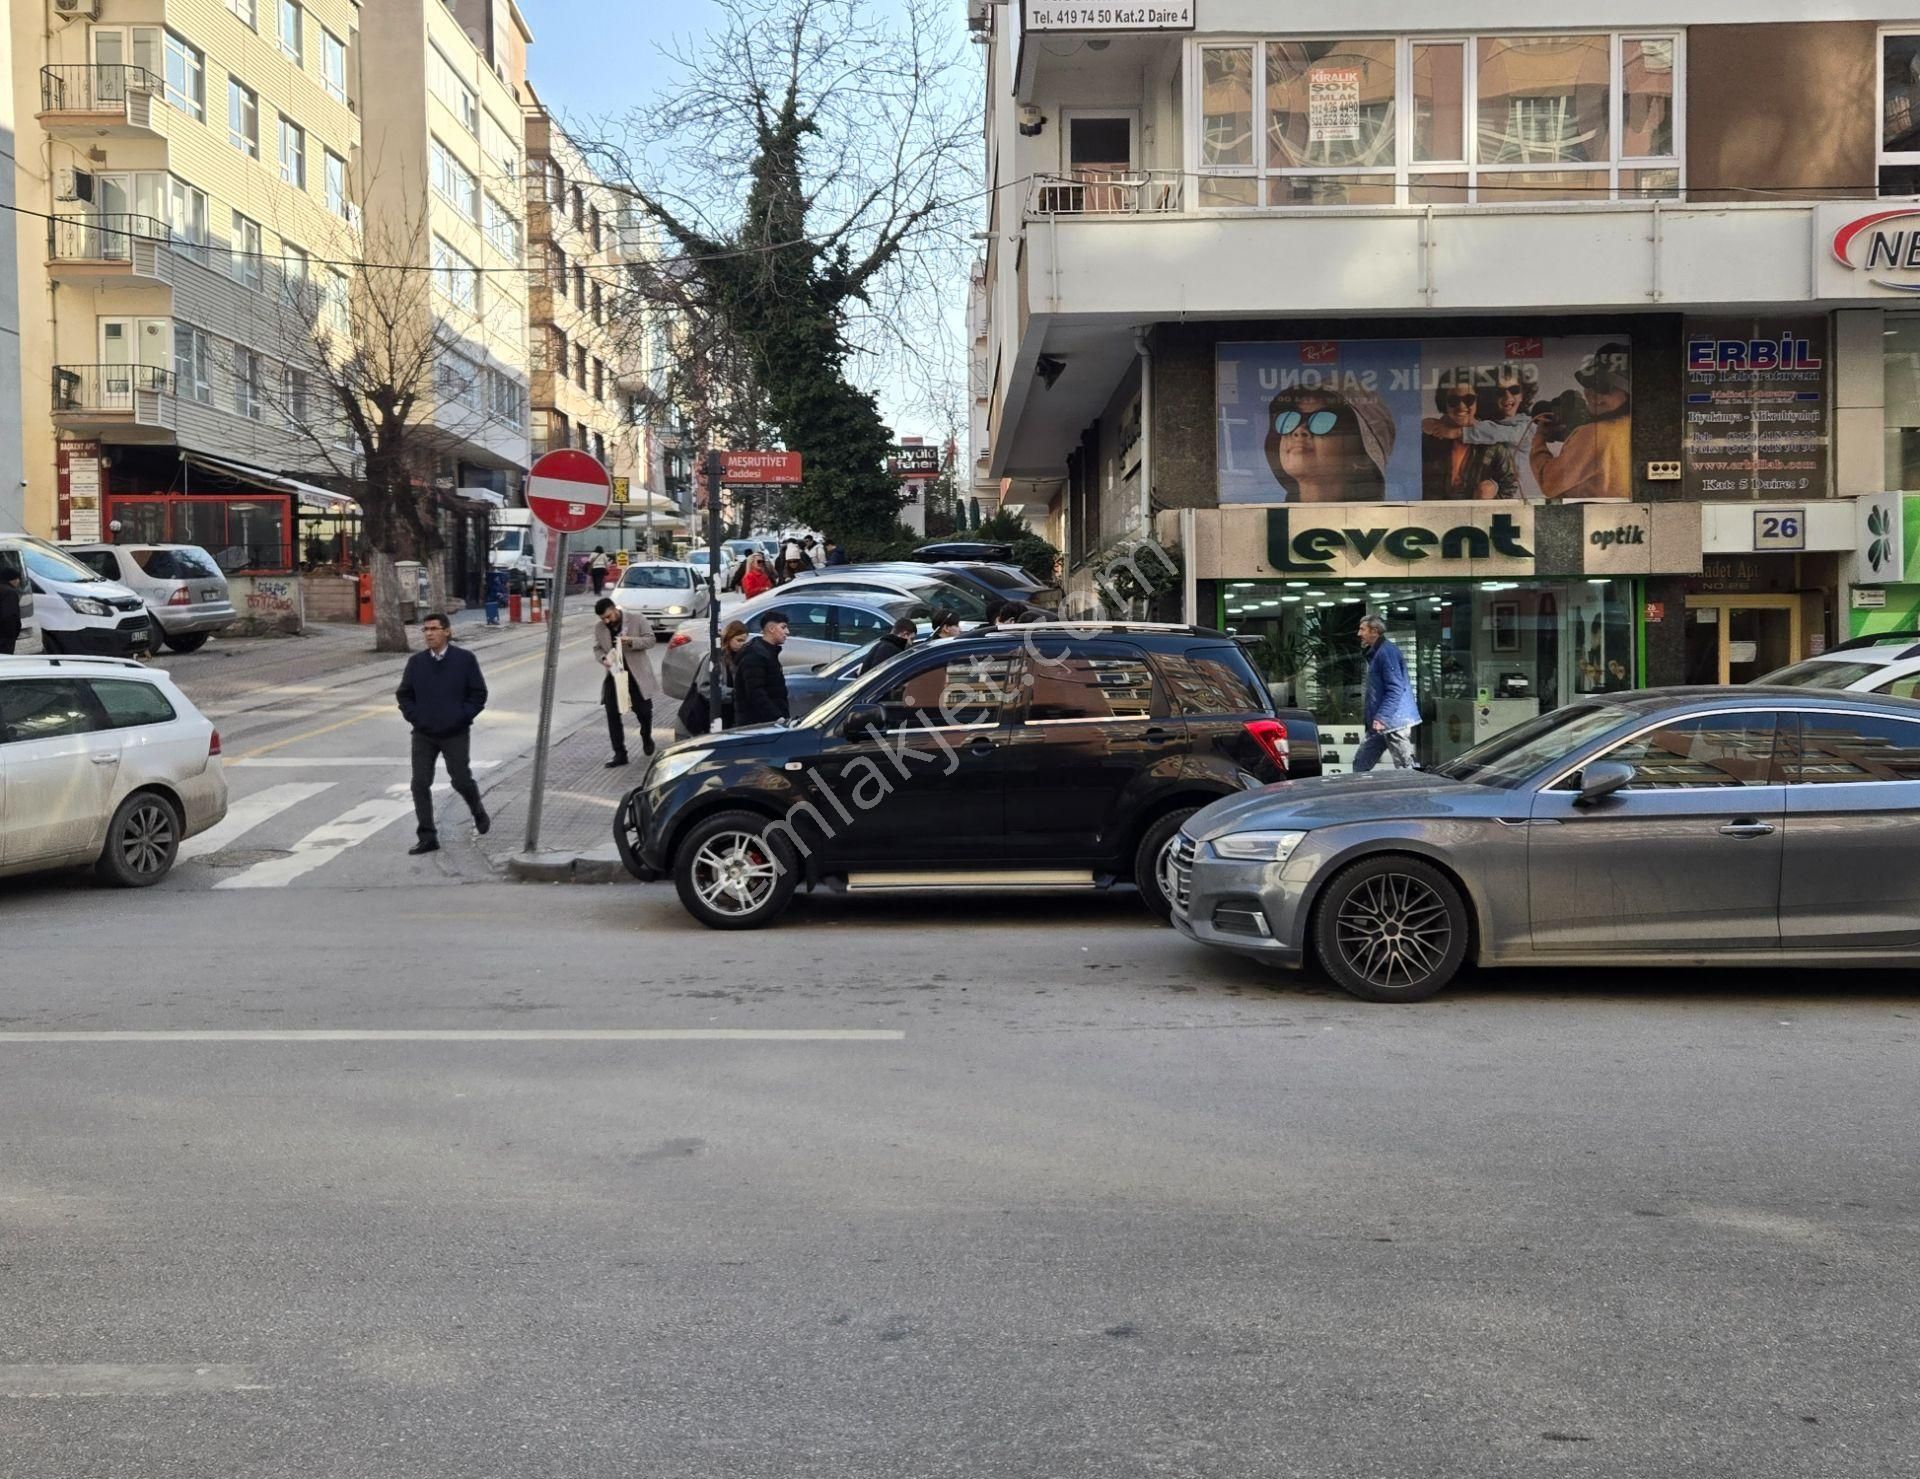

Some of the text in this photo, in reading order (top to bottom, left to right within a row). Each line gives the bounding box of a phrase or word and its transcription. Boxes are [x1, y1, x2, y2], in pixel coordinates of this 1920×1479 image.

[1032, 9, 1188, 24] Tel. 419 74 50 Kat.2 Daire 4
[1311, 71, 1358, 82] KİRALIK
[1688, 331, 1822, 371] ERBİL
[728, 455, 788, 467] MEŞRUTİYET
[897, 449, 936, 461] üyülü
[896, 460, 937, 469] fener
[728, 470, 761, 478] Caddesi
[1702, 479, 1735, 490] Kat:
[1751, 478, 1796, 490] Daire:
[1799, 478, 1809, 489] 9
[1762, 518, 1798, 538] 26
[1266, 508, 1644, 572] Levent optik
[1688, 560, 1732, 578] adet
